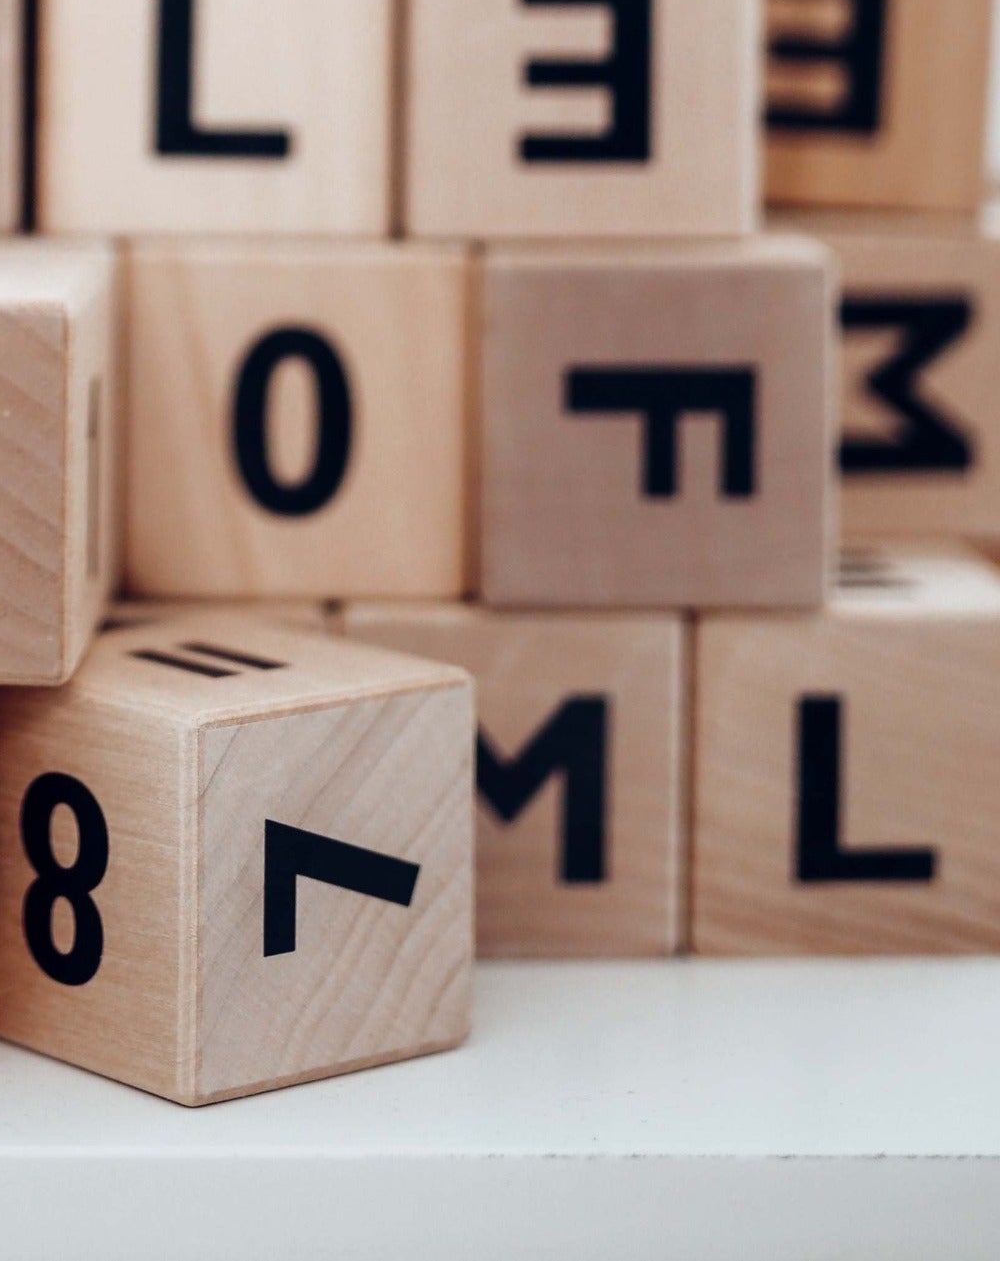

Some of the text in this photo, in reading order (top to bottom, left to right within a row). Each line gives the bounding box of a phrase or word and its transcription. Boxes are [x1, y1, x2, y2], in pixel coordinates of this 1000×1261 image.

[563, 363, 759, 501] F
[792, 693, 939, 888] L
[18, 772, 109, 986] 8
[264, 819, 420, 957] 7
